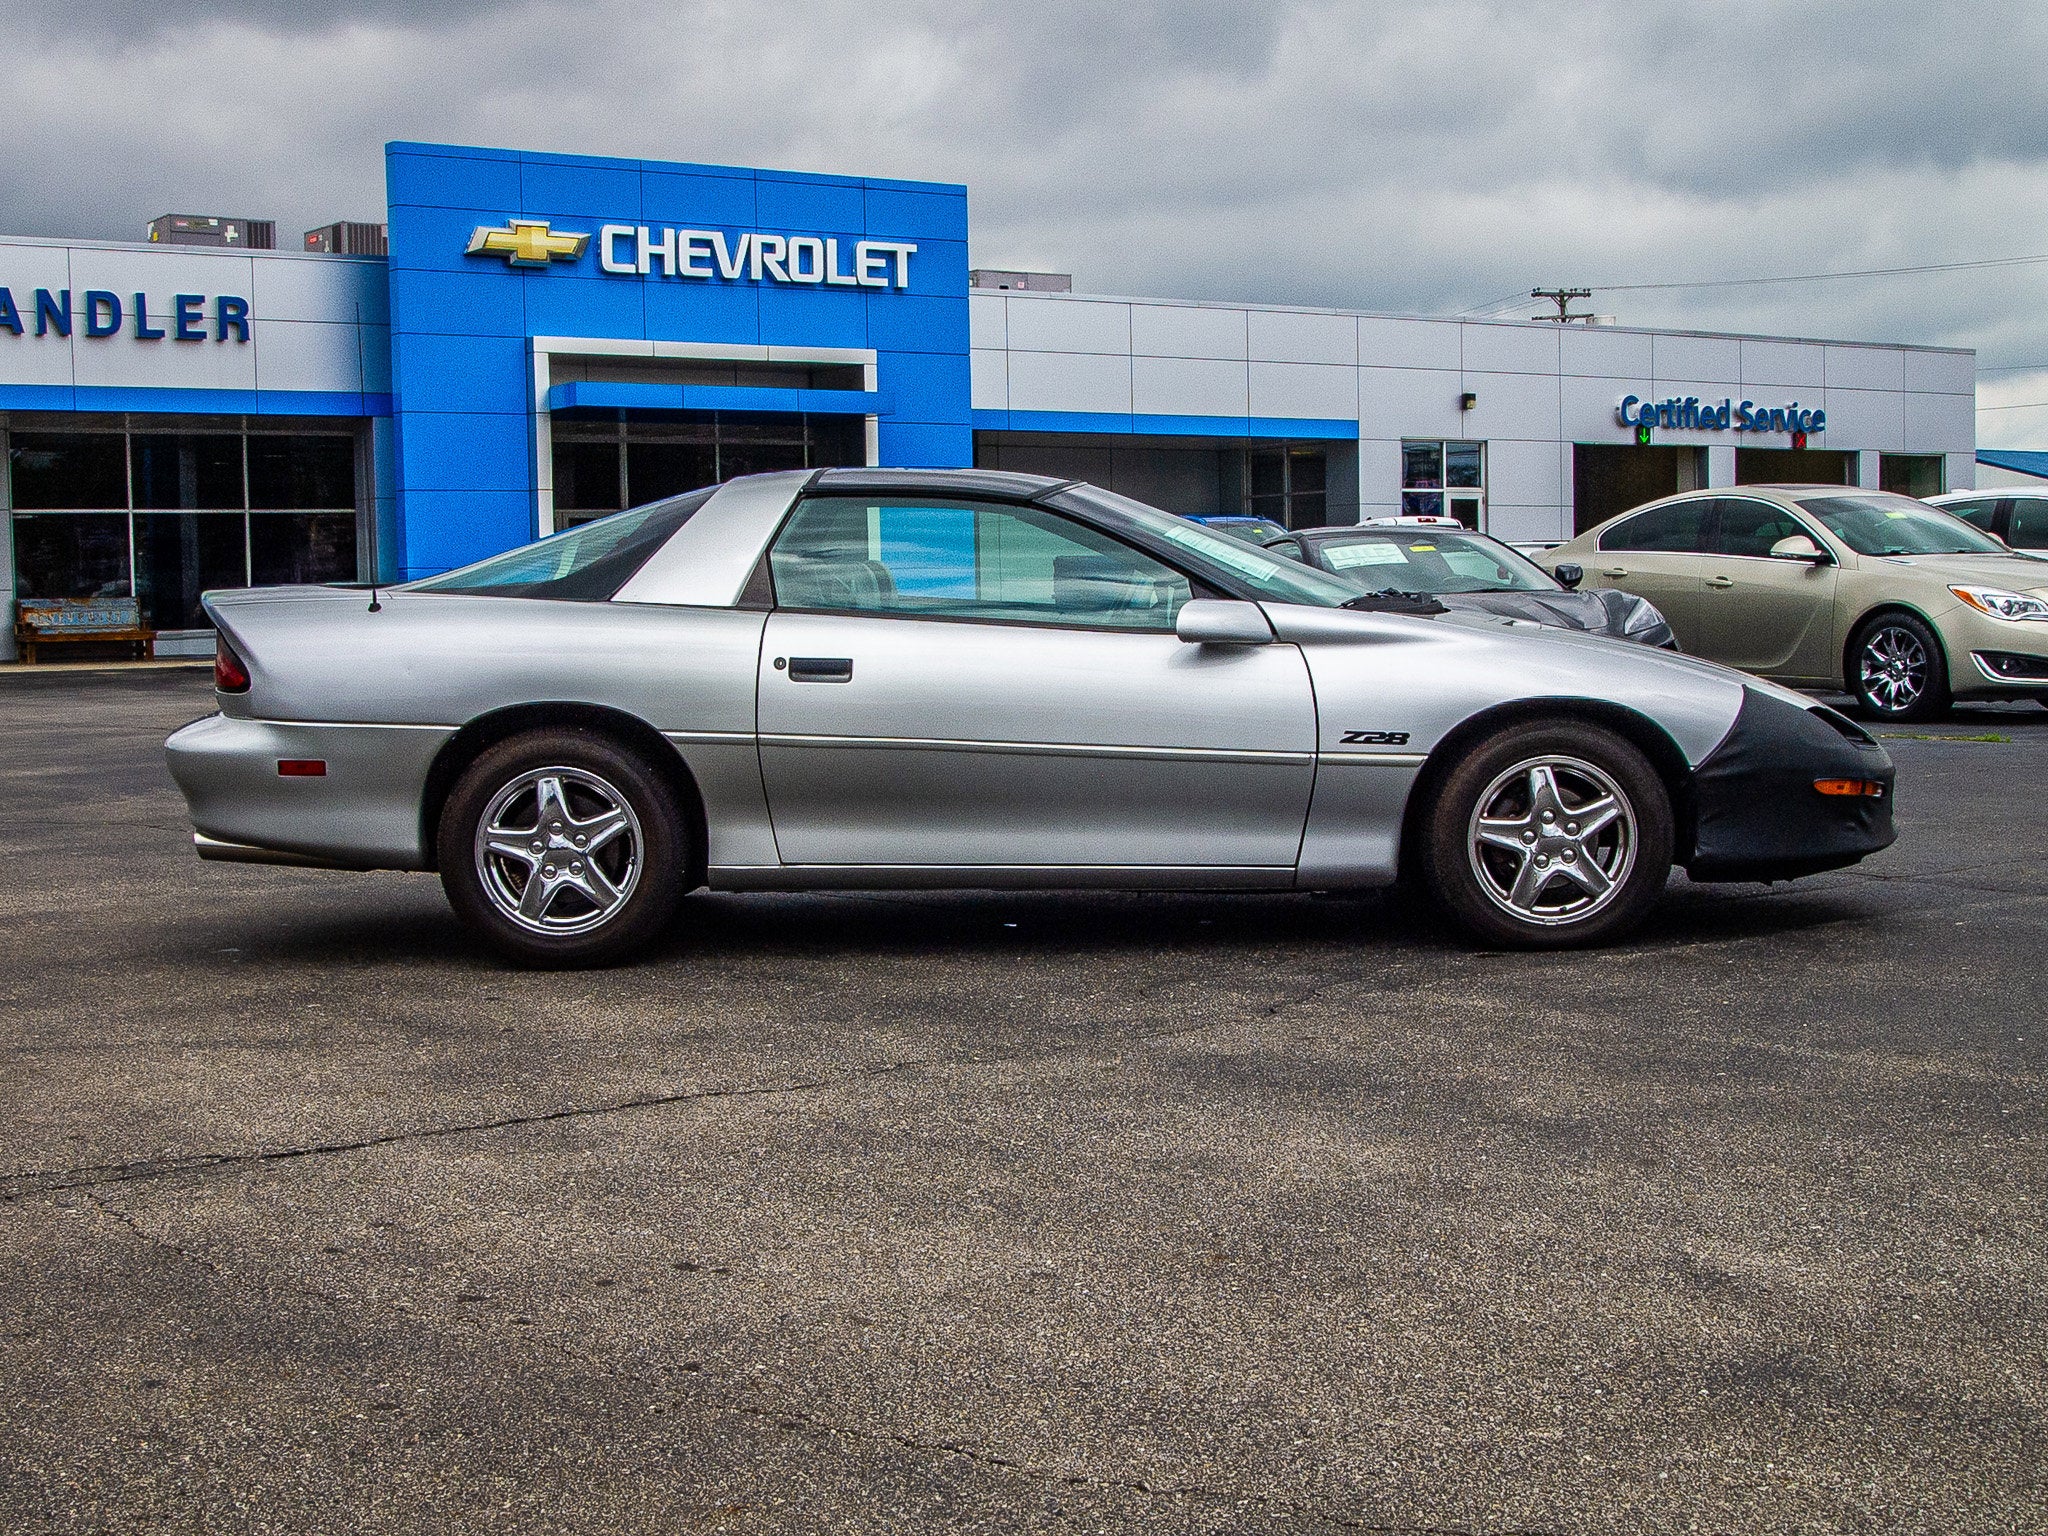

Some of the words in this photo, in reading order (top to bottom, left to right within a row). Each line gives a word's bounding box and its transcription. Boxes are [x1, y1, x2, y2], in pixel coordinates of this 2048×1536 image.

[600, 224, 917, 288] CHEVROLET
[1619, 395, 1731, 429] Certified
[1739, 400, 1826, 432] Service
[1339, 730, 1411, 746] Z28
